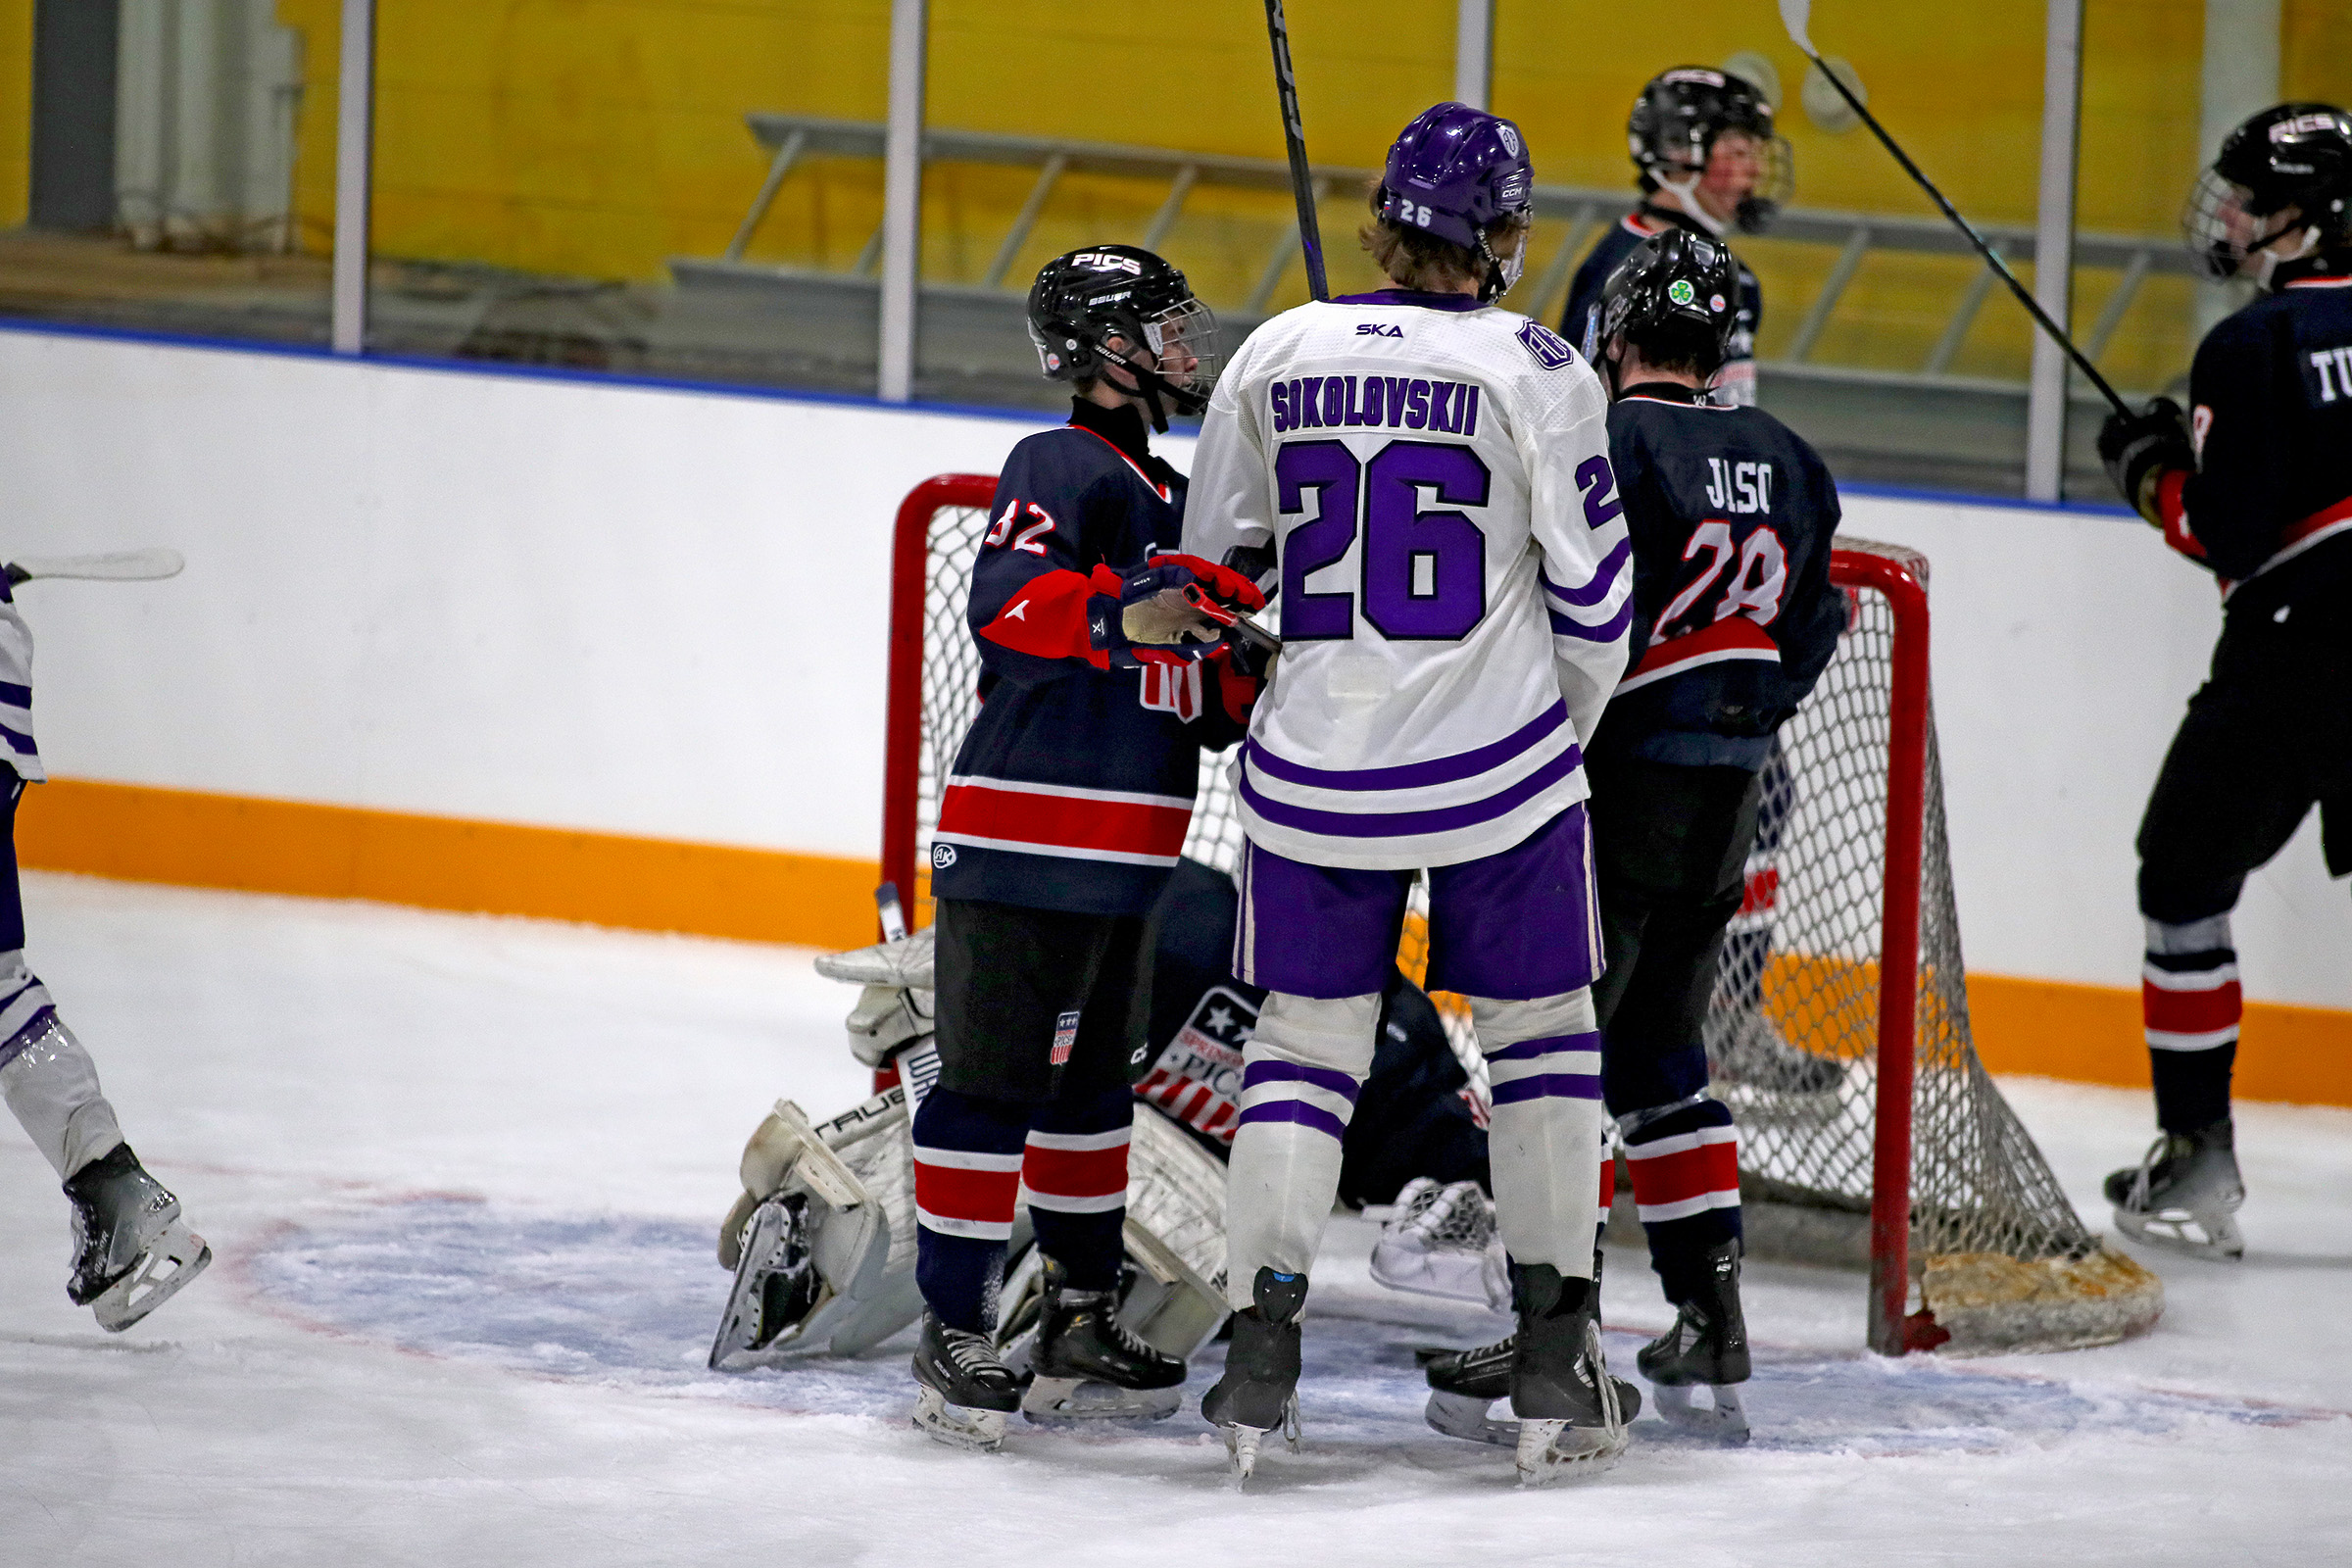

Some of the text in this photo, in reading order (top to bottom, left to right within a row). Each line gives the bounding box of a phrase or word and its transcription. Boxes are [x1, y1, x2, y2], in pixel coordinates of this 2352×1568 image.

[1502, 186, 1523, 198] CCM
[1399, 199, 1432, 227] 26
[1071, 253, 1142, 275] PICS
[1089, 291, 1132, 306] BAUER
[1355, 323, 1404, 338] SKA
[1095, 344, 1127, 365] BAUER
[1271, 375, 1480, 436] SOKOLOVSKII
[1274, 438, 1492, 642] 26
[1183, 1054, 1244, 1101] PIC
[813, 1088, 906, 1139] TRUE
